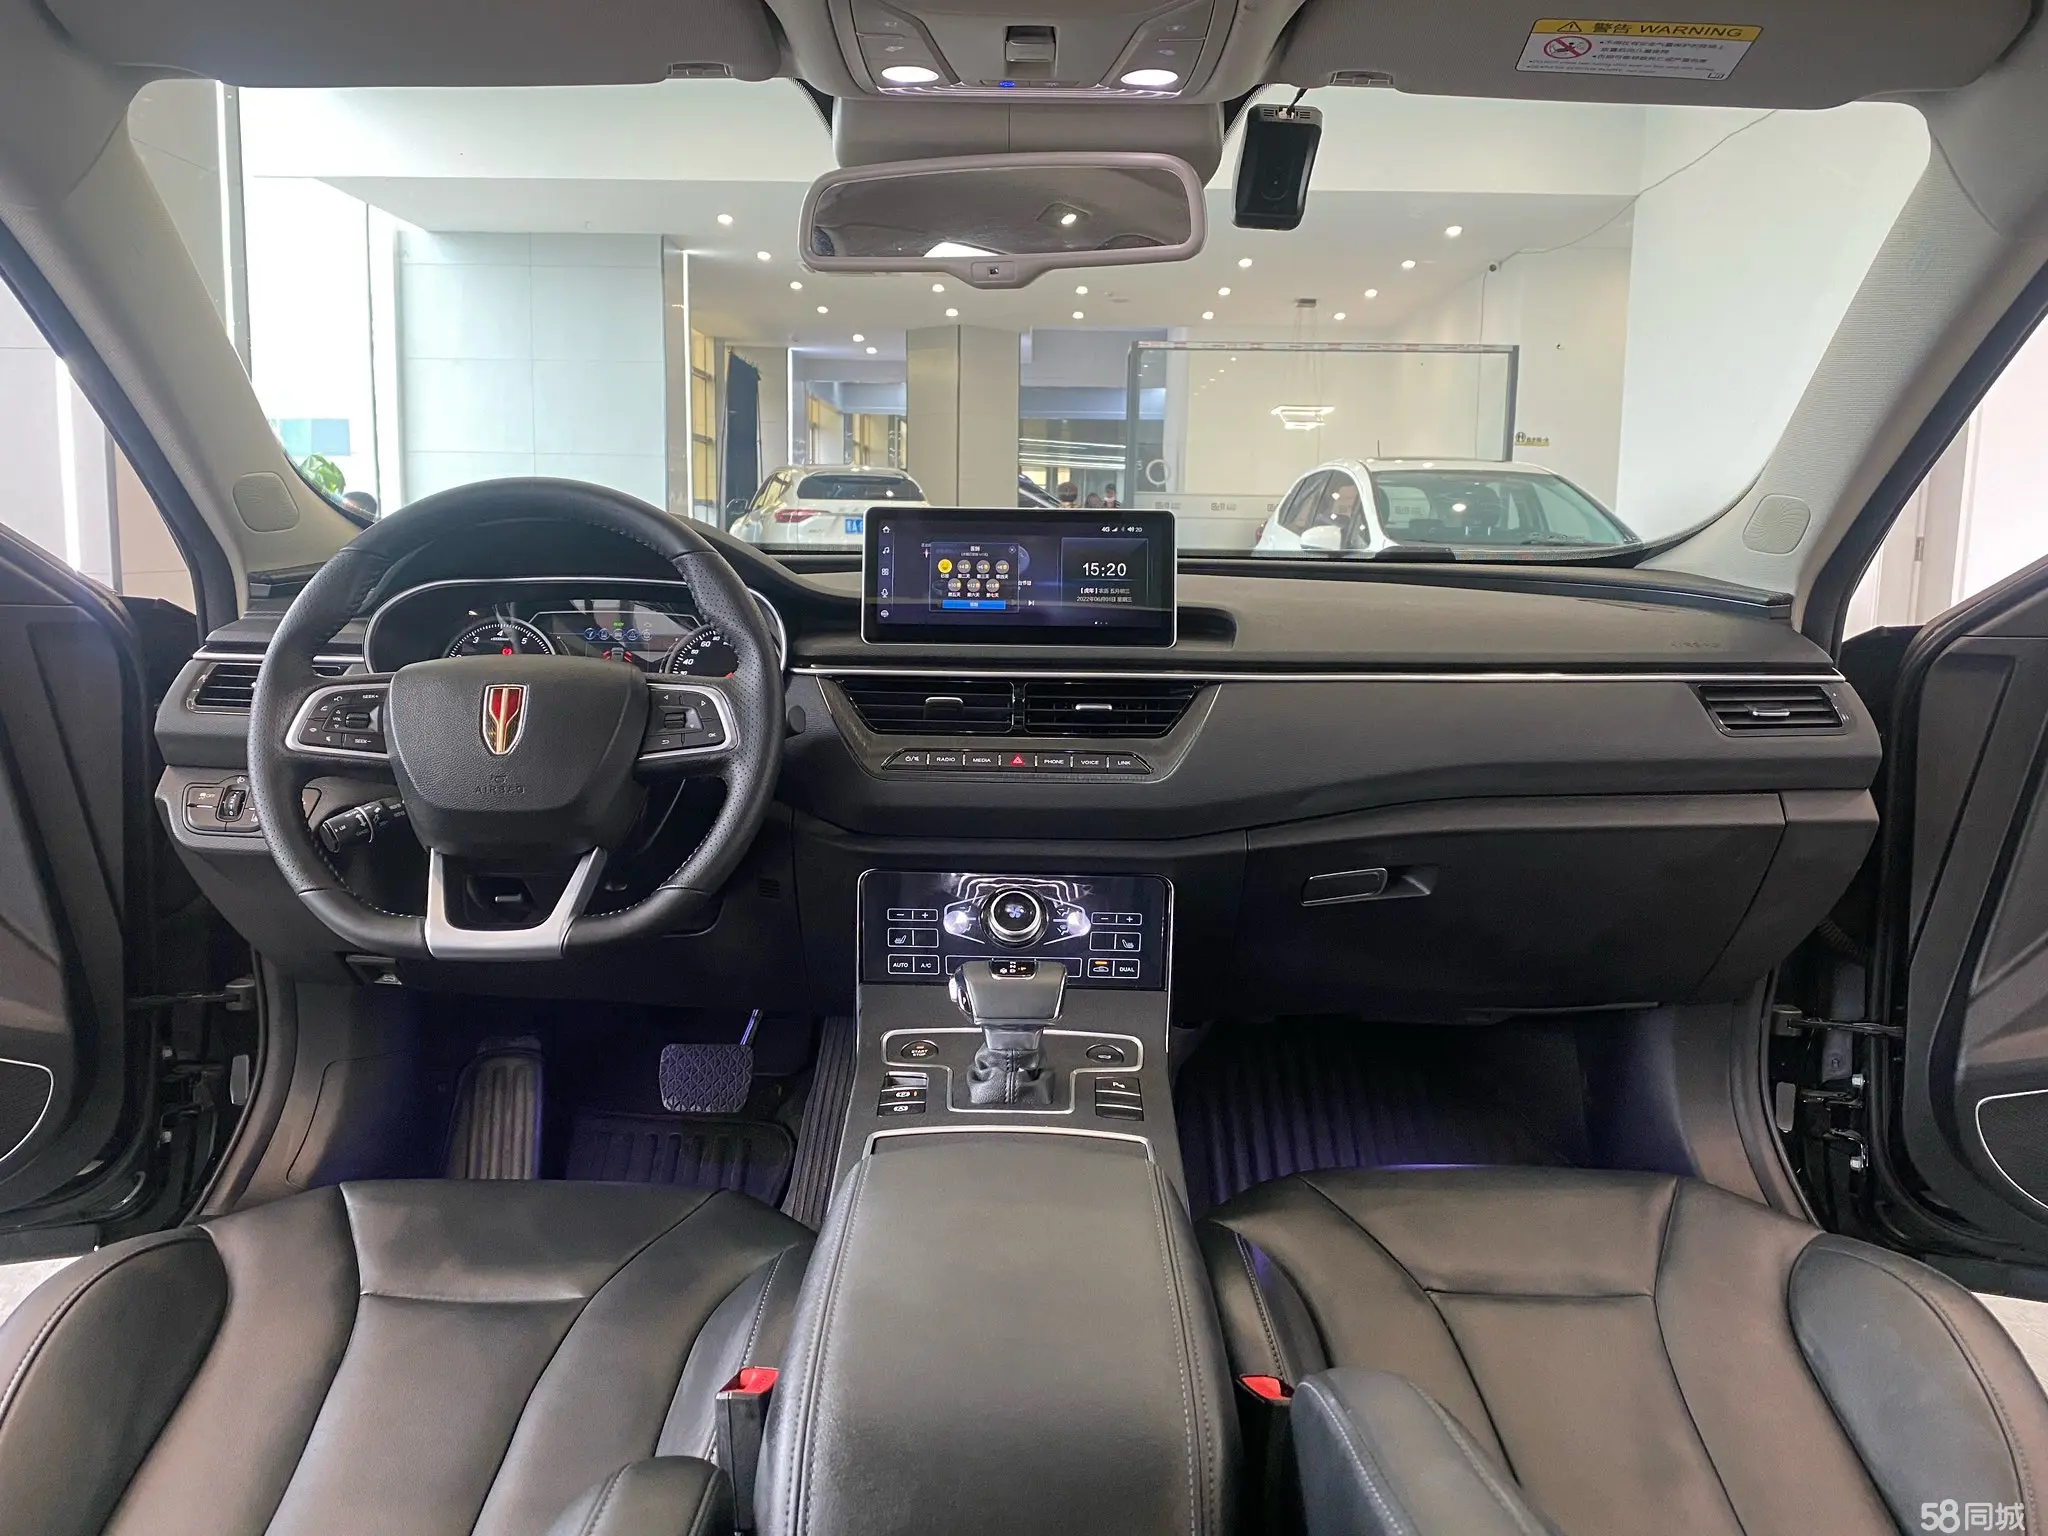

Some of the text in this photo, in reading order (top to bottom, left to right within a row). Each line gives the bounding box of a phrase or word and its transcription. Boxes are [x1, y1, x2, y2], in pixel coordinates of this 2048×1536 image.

[1593, 22, 1743, 36] 警告 WARNING
[1082, 562, 1127, 577] 15:20
[472, 636, 480, 644] 3
[521, 637, 528, 645] 5
